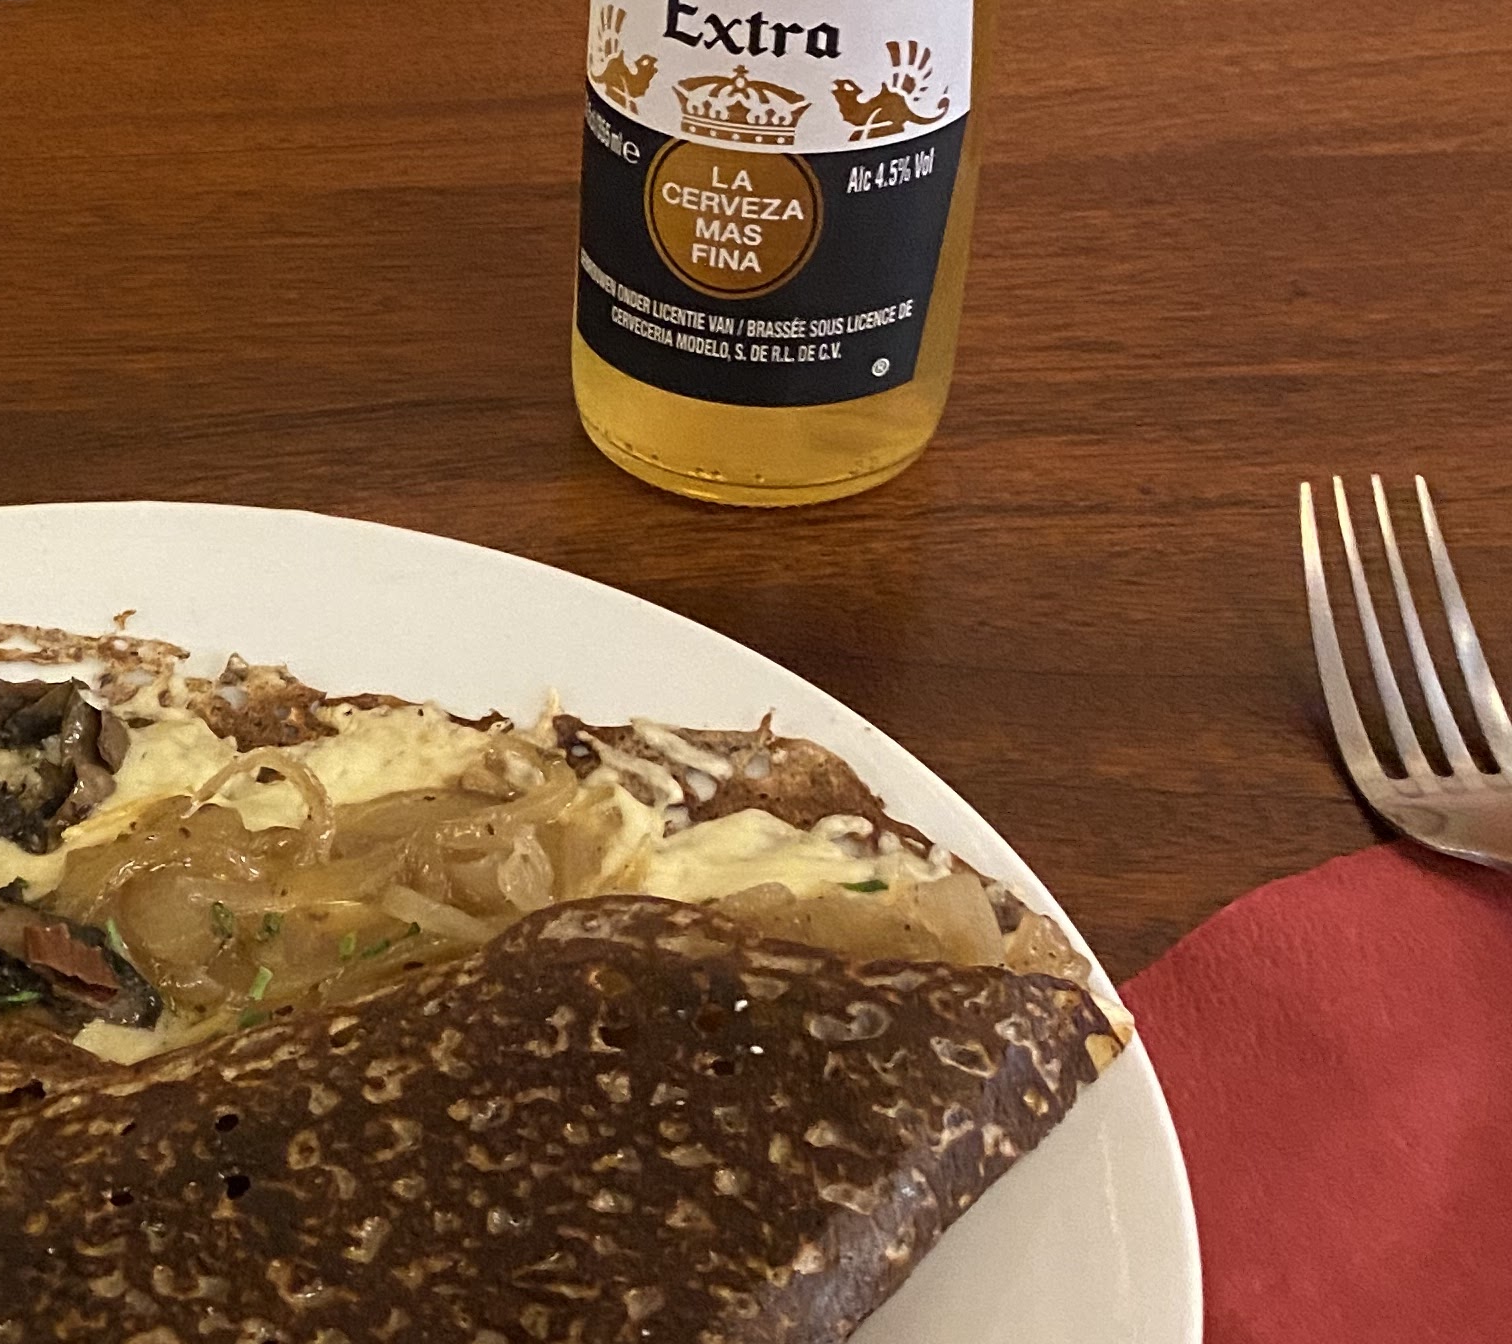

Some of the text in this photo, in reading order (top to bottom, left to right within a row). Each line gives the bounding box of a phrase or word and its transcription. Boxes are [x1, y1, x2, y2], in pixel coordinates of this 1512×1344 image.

[711, 165, 753, 192] LA
[846, 147, 935, 193] Alc 4.5% Vol
[661, 181, 804, 220] CERVEZA
[695, 217, 763, 246] MAS
[691, 242, 762, 273] FINA
[617, 283, 651, 315] ONDER
[652, 299, 706, 330] LICENTIE
[708, 313, 735, 336] VAN
[809, 317, 845, 337] SOUS
[846, 305, 897, 334] LICENCE
[898, 299, 914, 321] DE
[611, 305, 674, 347] CERVECERIA
[750, 344, 769, 362] DE
[797, 344, 815, 362] DE
